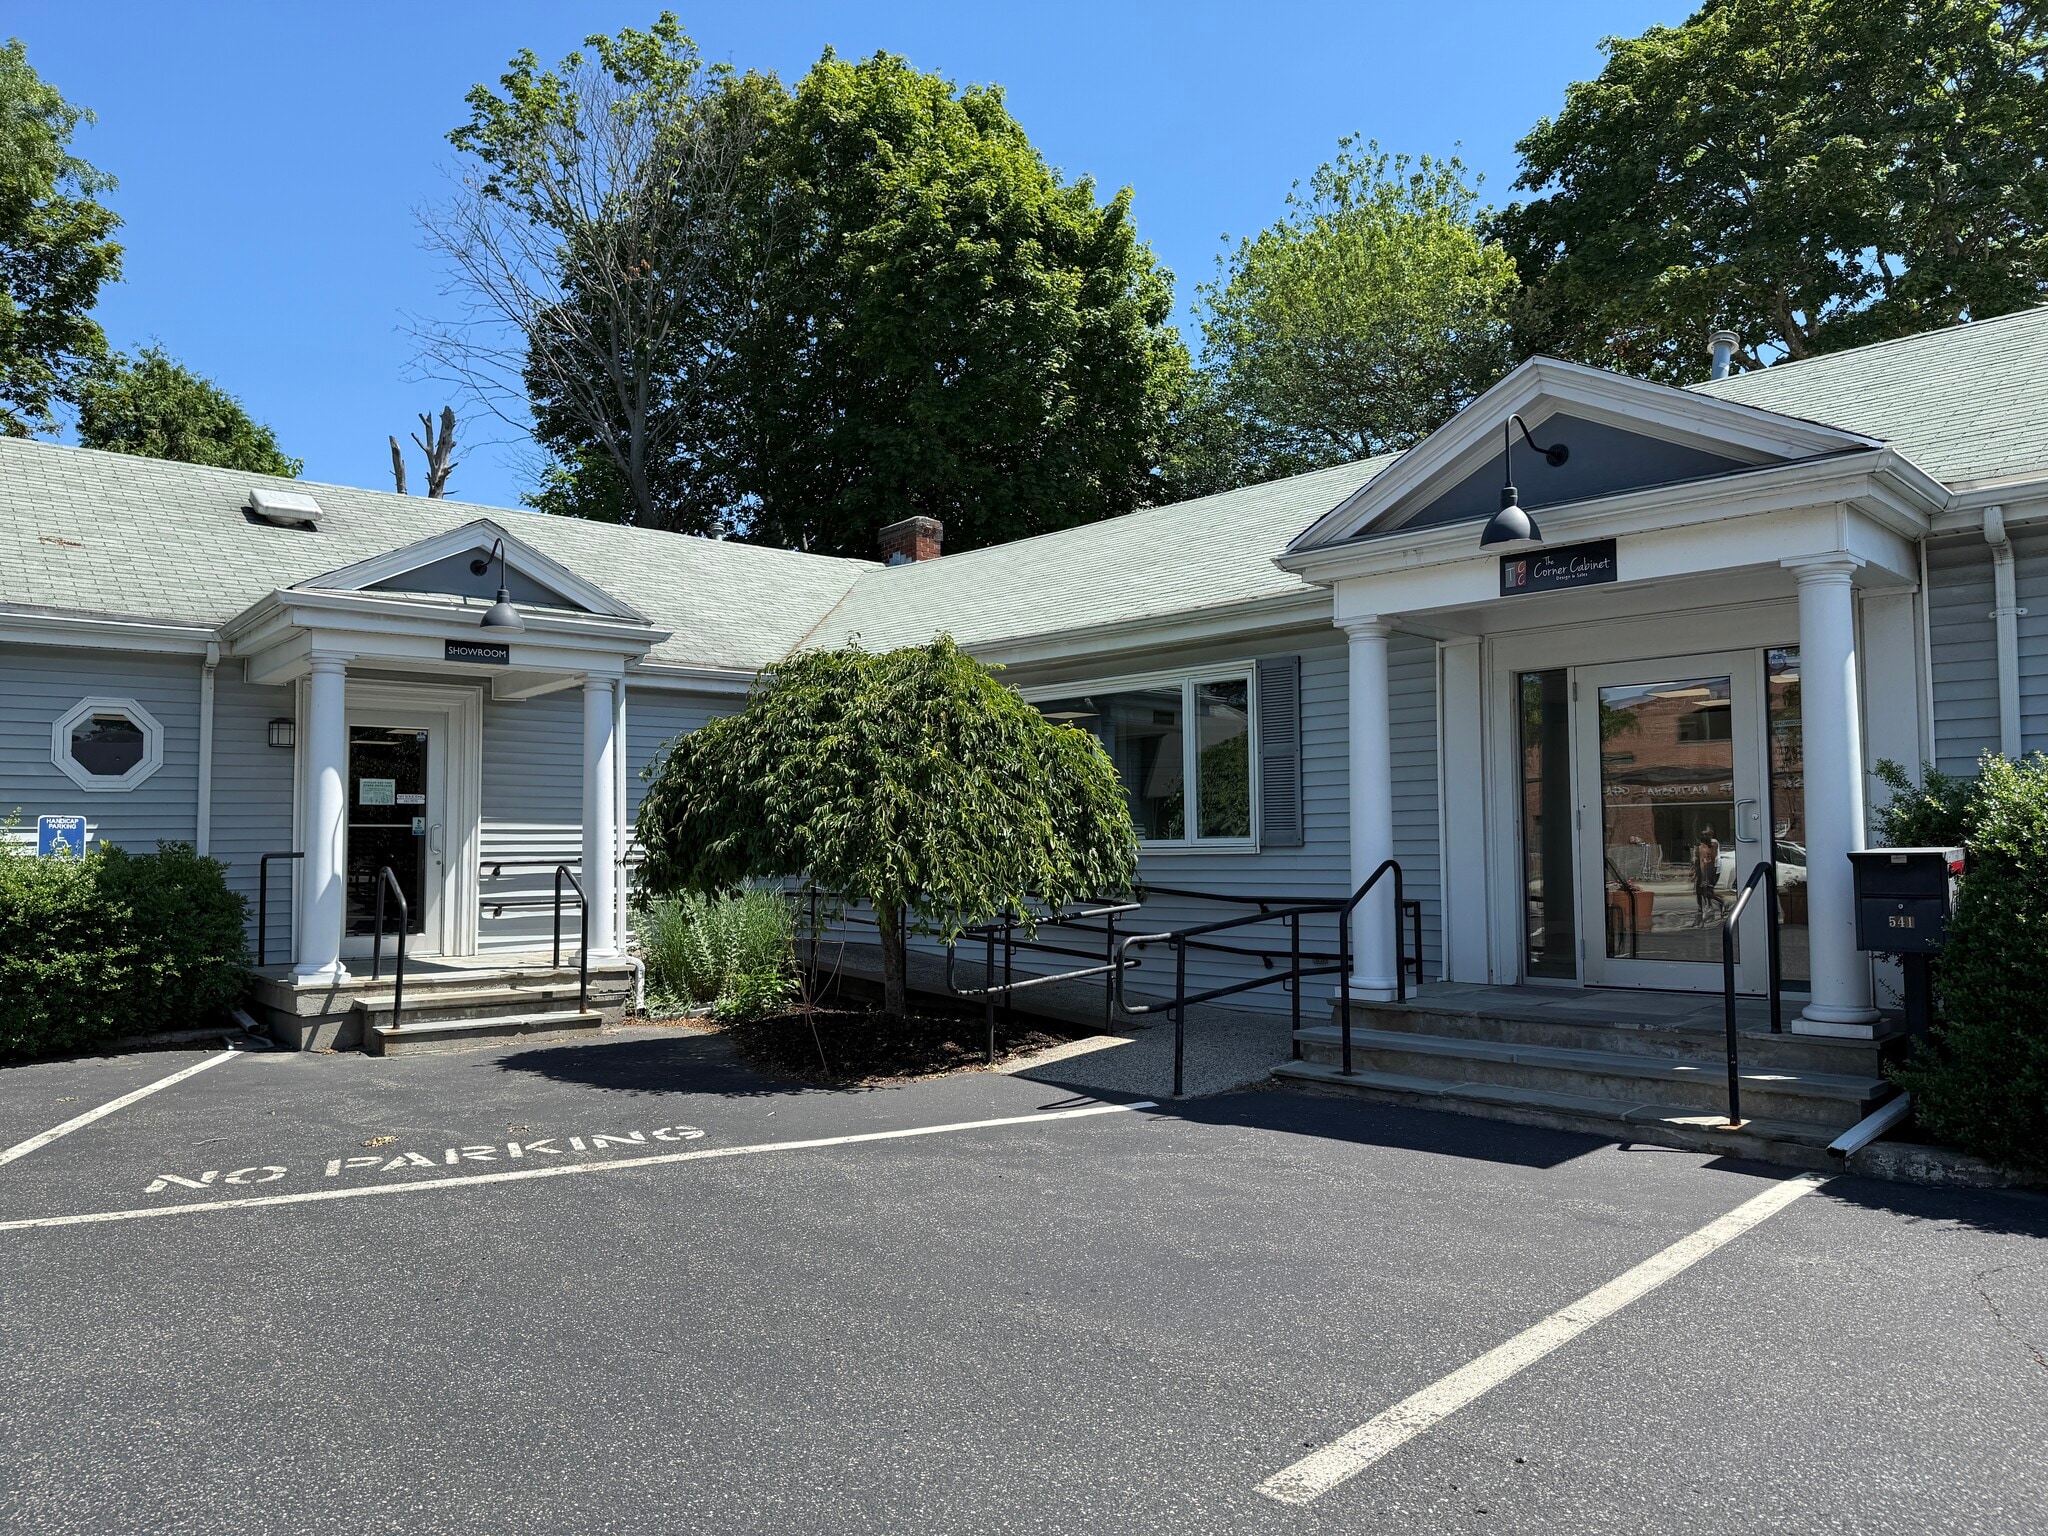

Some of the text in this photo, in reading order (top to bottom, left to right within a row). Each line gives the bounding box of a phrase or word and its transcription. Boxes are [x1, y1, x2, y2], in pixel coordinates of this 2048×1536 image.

[1543, 556, 1555, 566] The
[1533, 557, 1611, 578] Corner Cabinet
[448, 646, 506, 658] SHOWROOM
[1889, 916, 1913, 928] 541
[144, 1125, 706, 1193] NO PARKING
